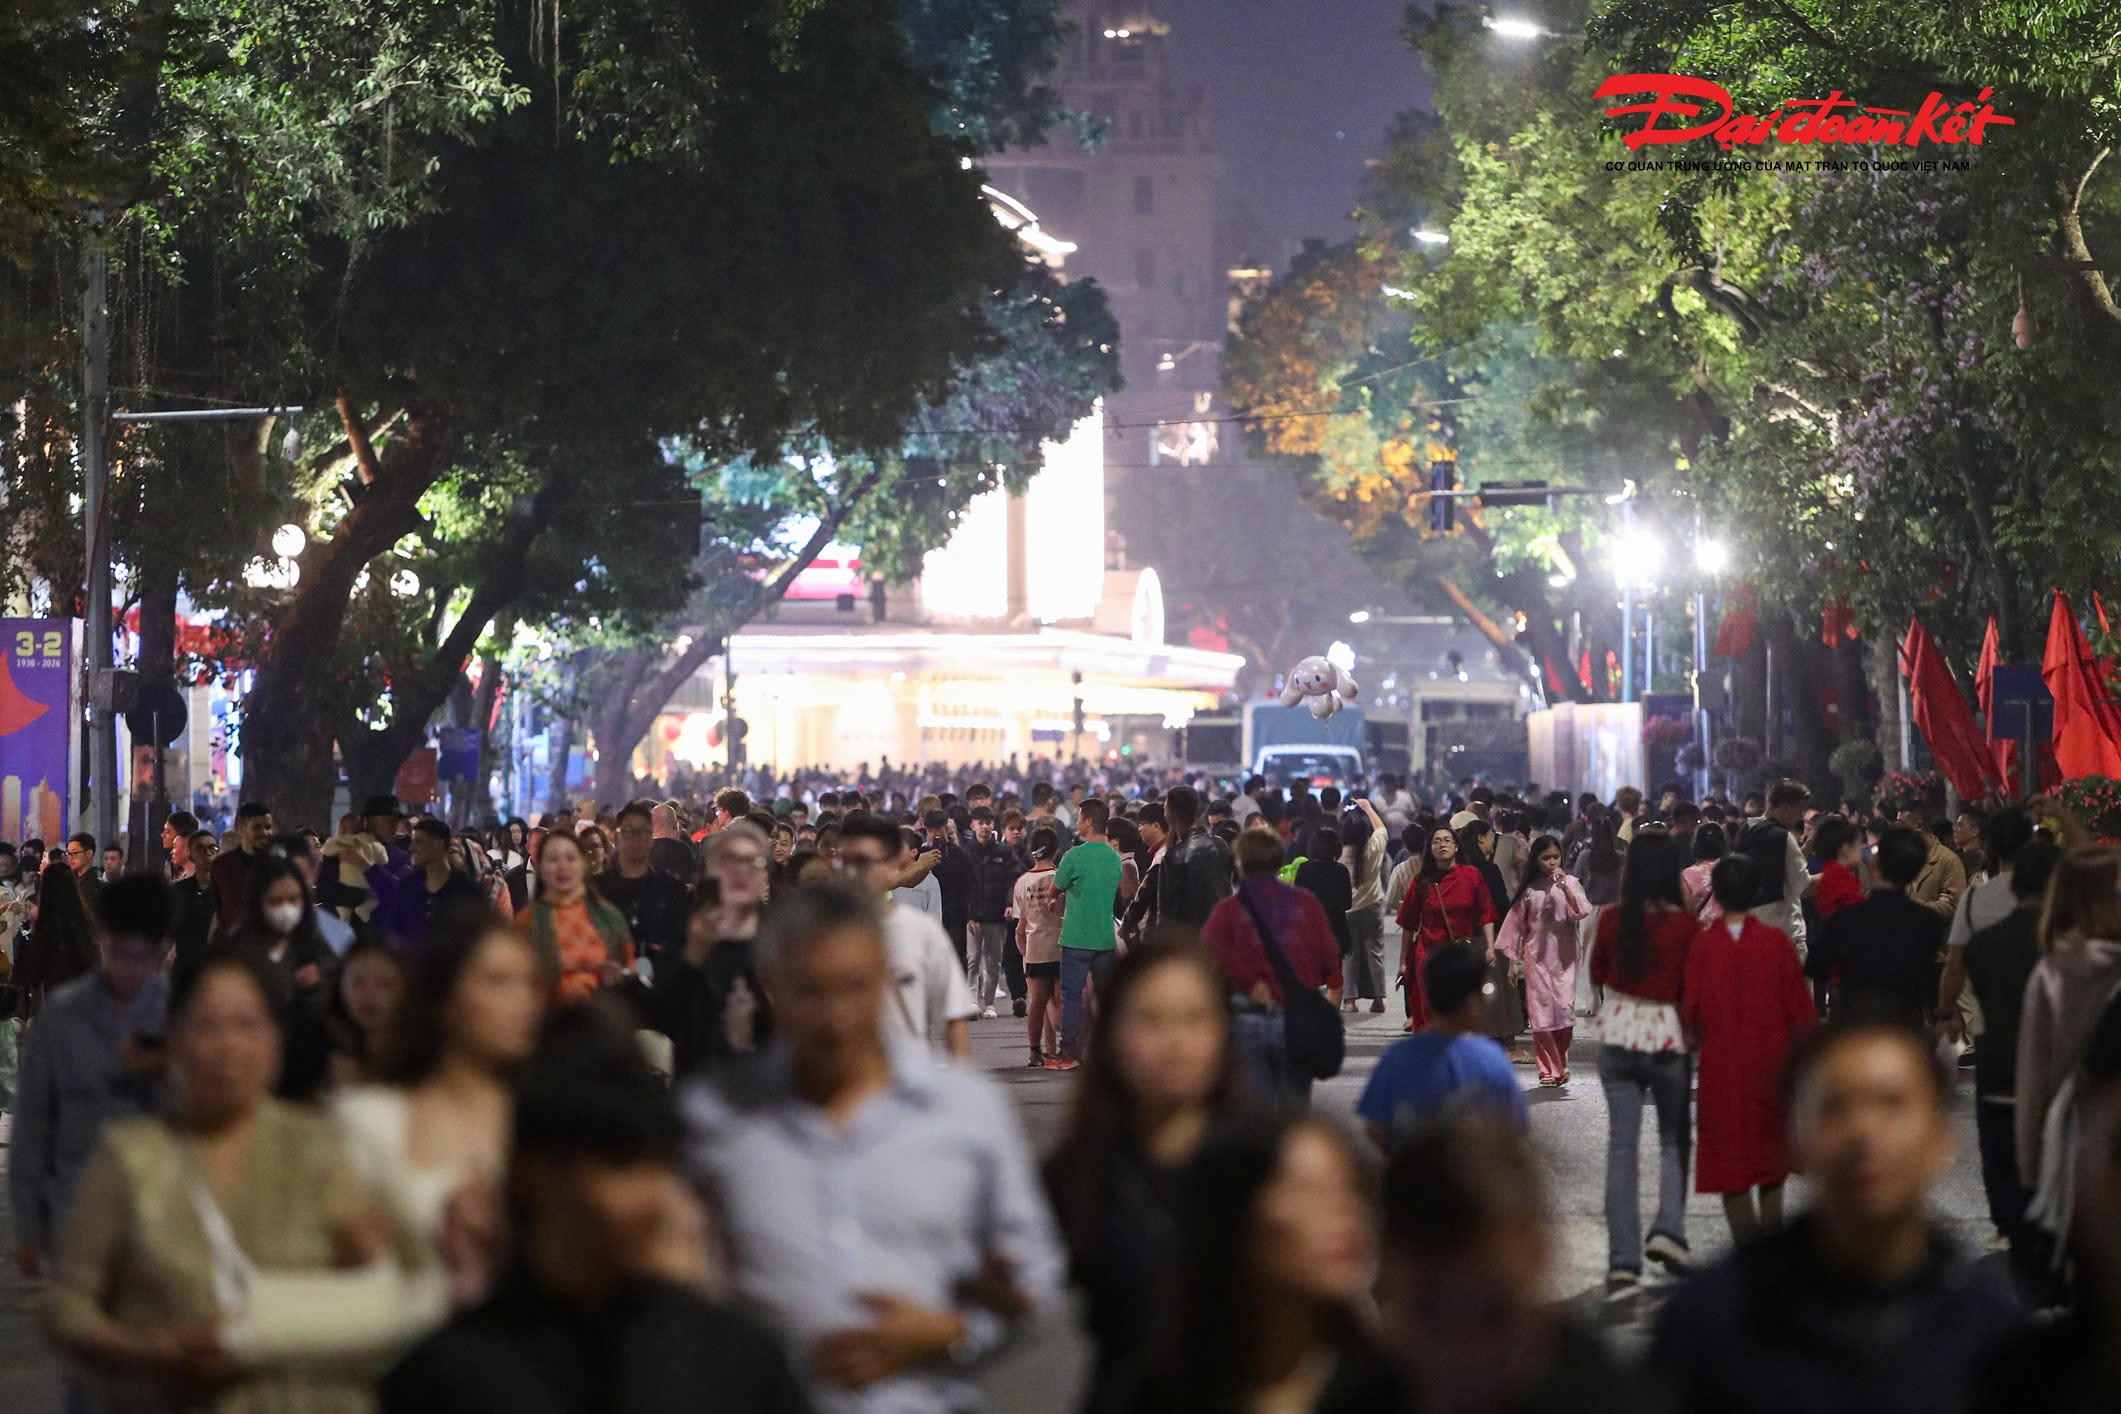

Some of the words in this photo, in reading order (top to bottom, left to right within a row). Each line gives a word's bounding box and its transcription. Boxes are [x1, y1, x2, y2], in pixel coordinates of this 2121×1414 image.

[15, 631, 62, 657] 3-2
[17, 658, 36, 668] 1930
[42, 658, 61, 668] 2026
